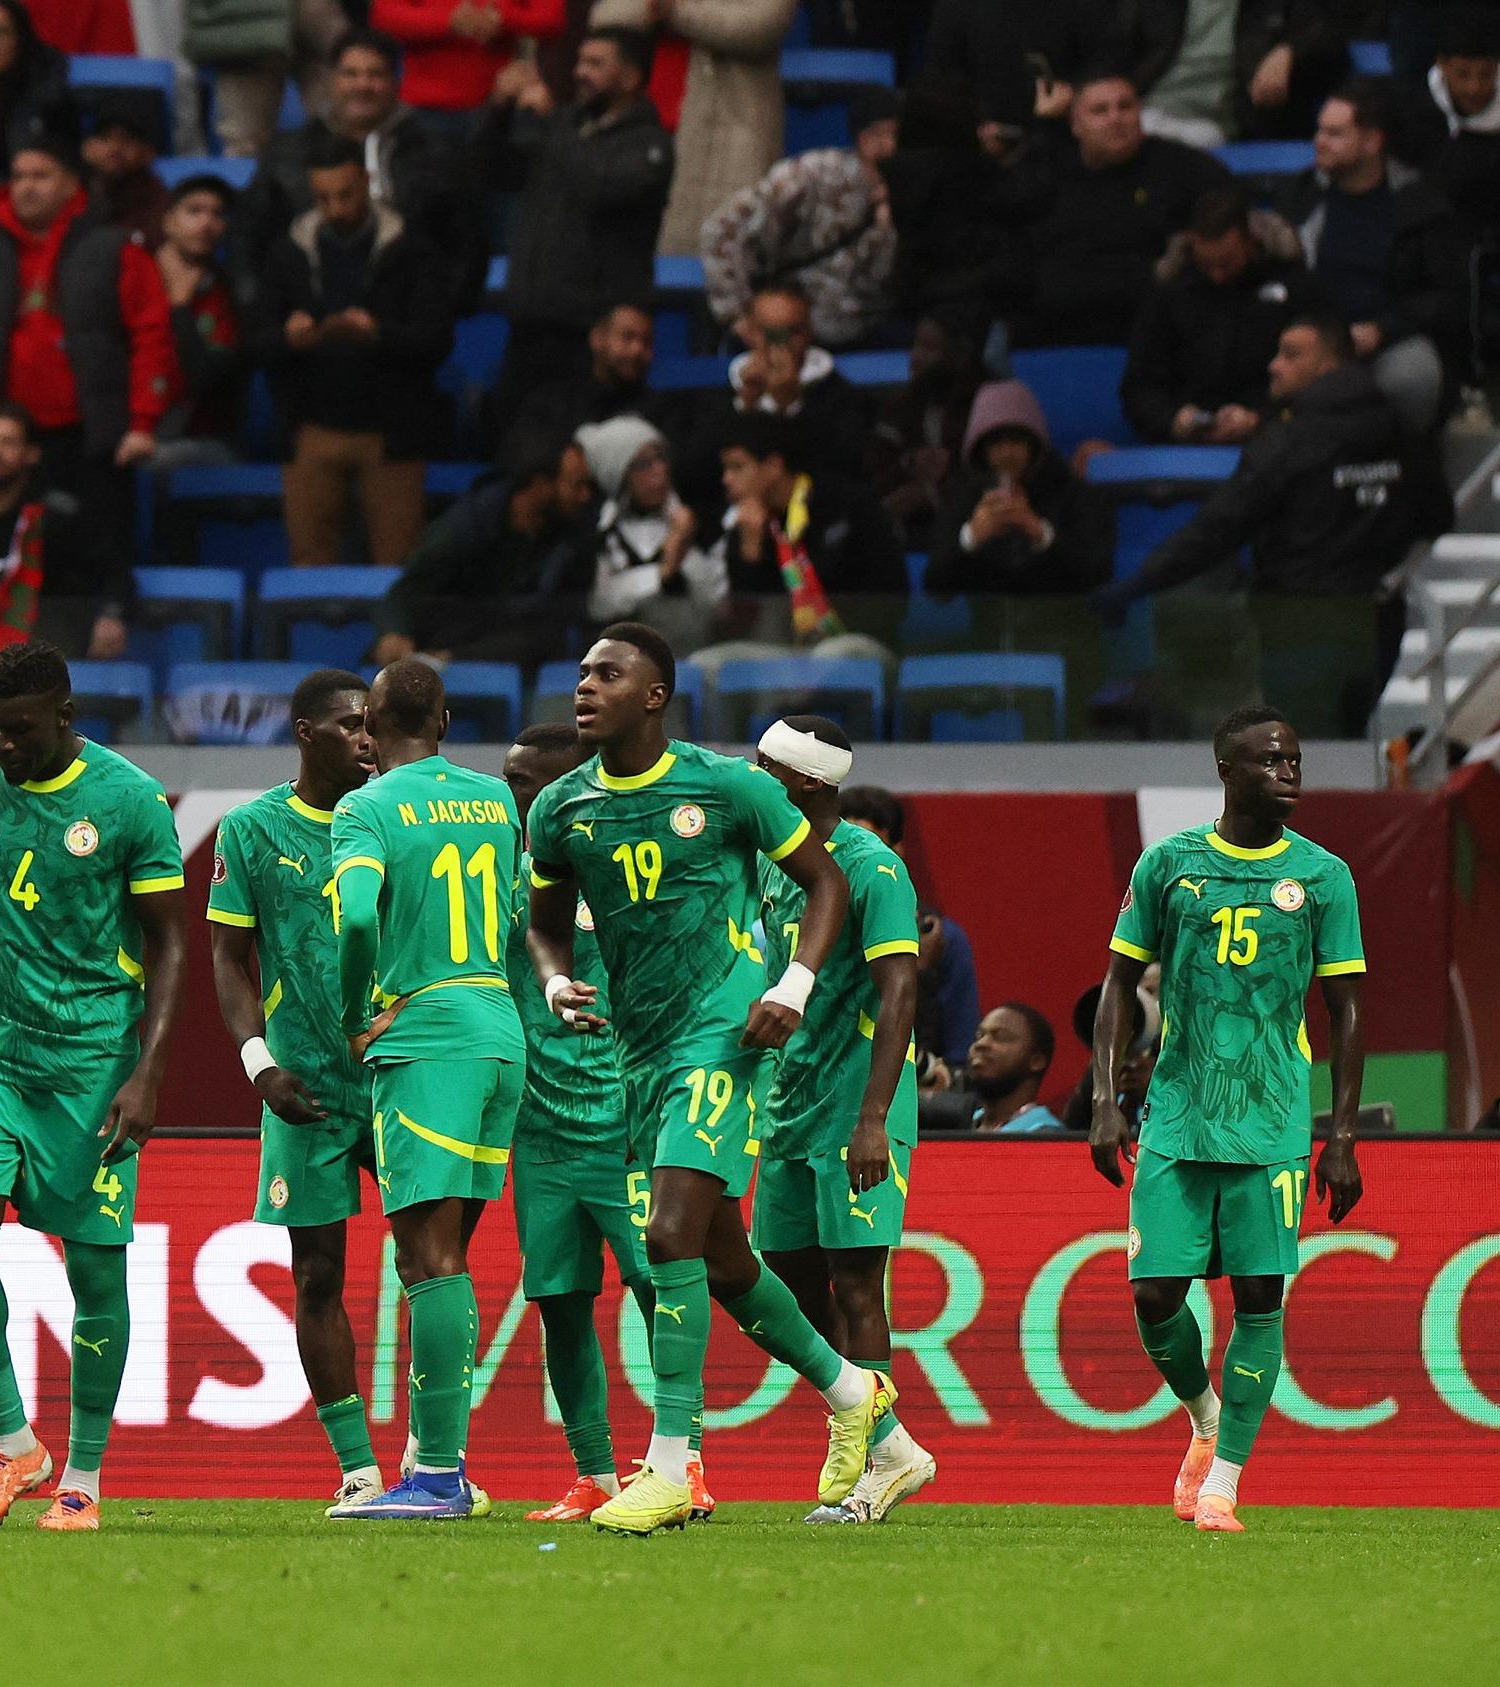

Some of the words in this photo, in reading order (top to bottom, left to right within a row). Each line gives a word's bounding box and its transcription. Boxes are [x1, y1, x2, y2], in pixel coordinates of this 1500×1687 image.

[398, 803, 422, 827] N.
[429, 799, 509, 825] JACKSON
[9, 850, 41, 911] 4
[611, 839, 663, 903] 19
[321, 878, 342, 936] 1
[430, 842, 499, 965] 11
[1210, 906, 1262, 966] 15
[684, 1068, 734, 1127] 19
[92, 1166, 123, 1202] 4
[626, 1171, 651, 1227] 5
